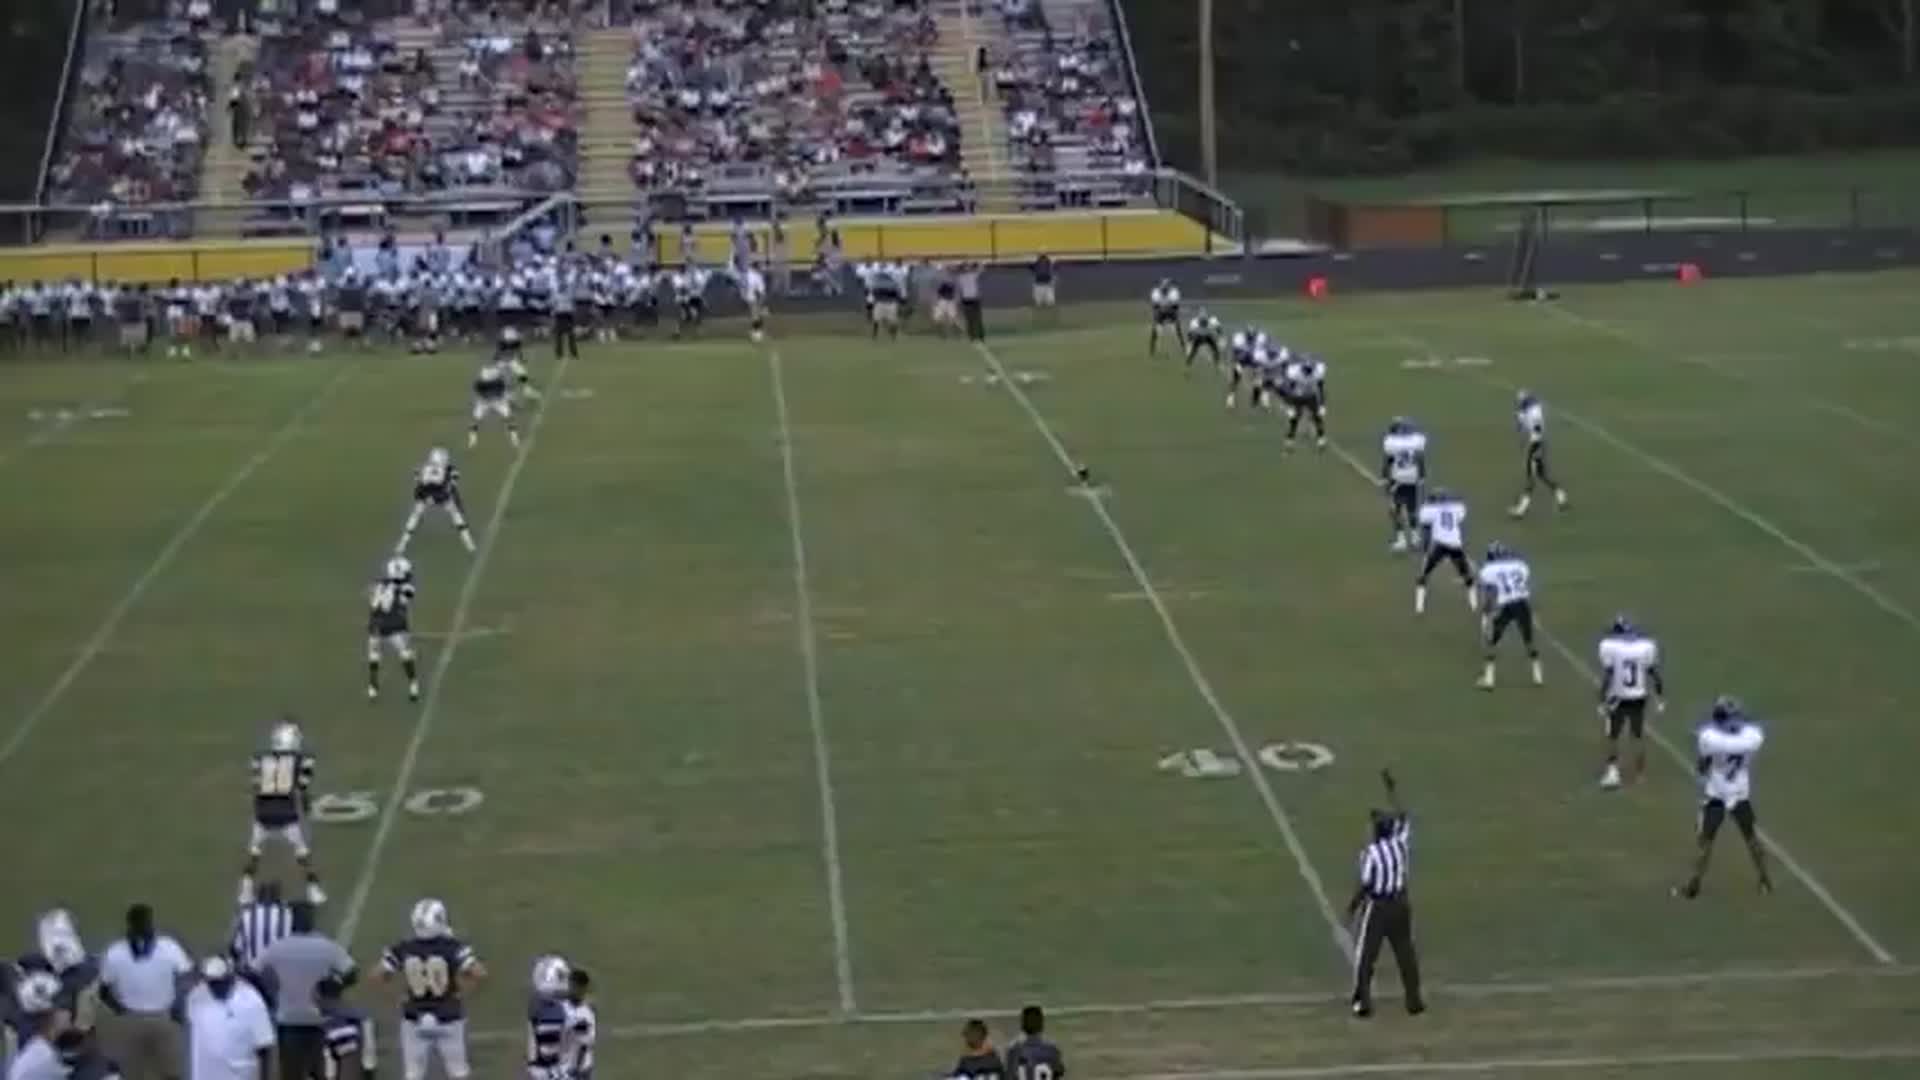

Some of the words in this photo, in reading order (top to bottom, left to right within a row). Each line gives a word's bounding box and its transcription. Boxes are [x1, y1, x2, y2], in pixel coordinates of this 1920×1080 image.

[1623, 659, 1638, 688] 3
[1157, 742, 1336, 777] 40
[1727, 753, 1745, 782] 7
[310, 787, 485, 822] 50
